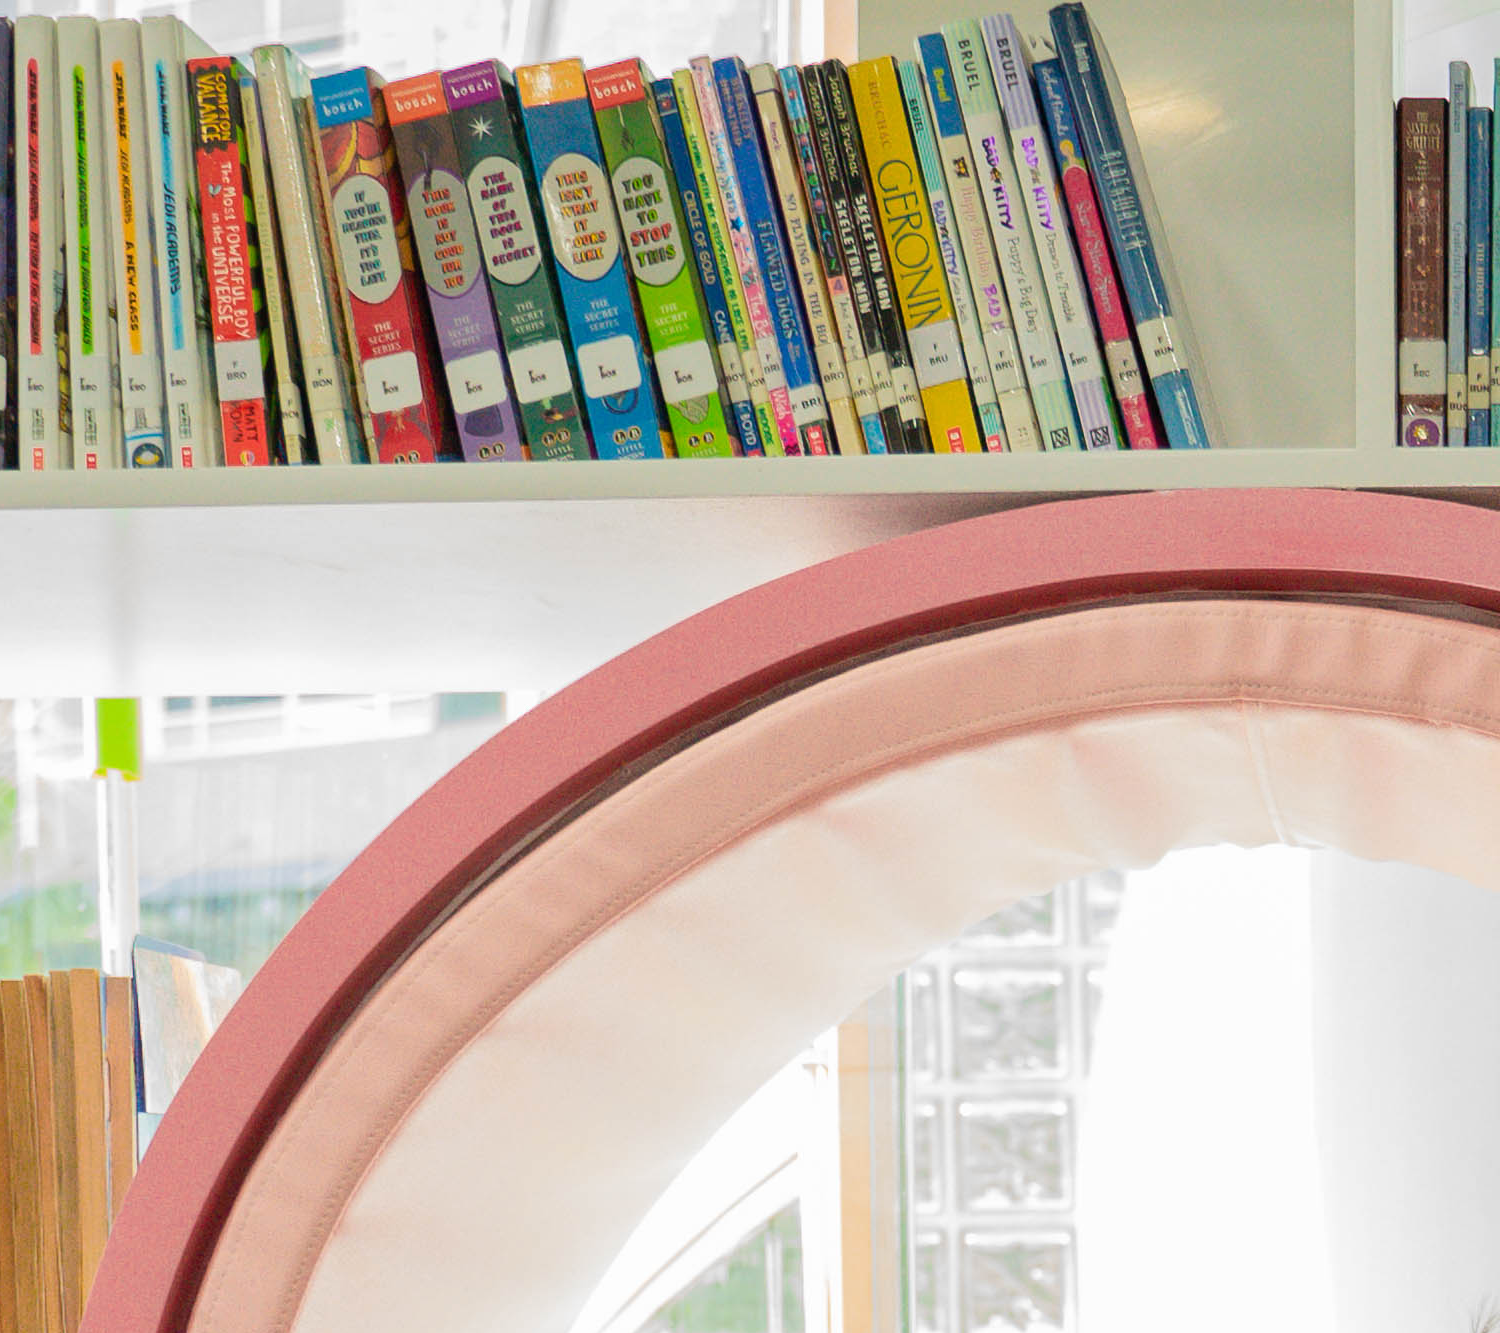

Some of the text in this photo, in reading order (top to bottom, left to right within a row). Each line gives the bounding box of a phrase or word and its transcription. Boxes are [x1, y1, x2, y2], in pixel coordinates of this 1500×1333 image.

[958, 39, 979, 92] BRUEL
[997, 37, 1019, 90] BRUEL
[196, 74, 219, 143] VALANCE
[213, 72, 233, 141] COMPTON
[621, 174, 654, 191] YOU
[623, 192, 661, 210] HAVE
[629, 227, 671, 245] STOP
[636, 210, 658, 225] TO
[220, 161, 251, 337] The Most POWERFUL BOY
[636, 245, 677, 262] THIS
[213, 244, 233, 326] UNIVERSE
